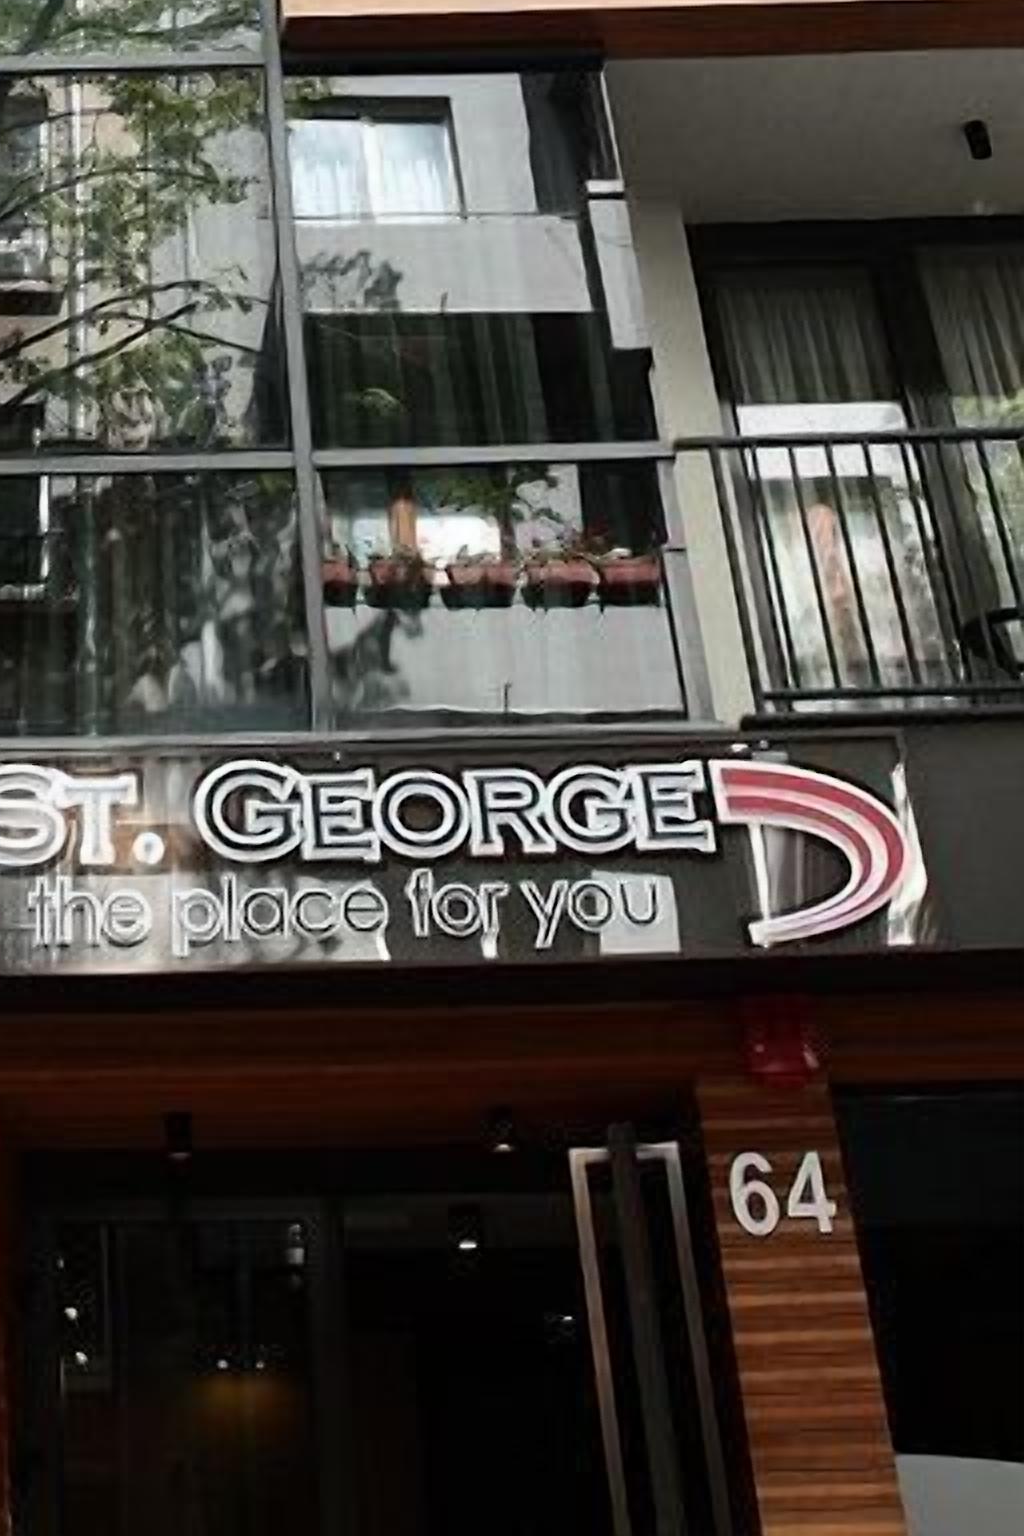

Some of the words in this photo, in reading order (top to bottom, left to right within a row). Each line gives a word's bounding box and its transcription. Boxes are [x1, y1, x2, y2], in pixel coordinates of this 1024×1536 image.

[193, 759, 717, 864] GEORGE
[27, 874, 153, 949] the
[171, 872, 389, 959] place
[404, 867, 509, 941] for
[519, 877, 659, 951] you
[729, 1151, 837, 1236] 64
